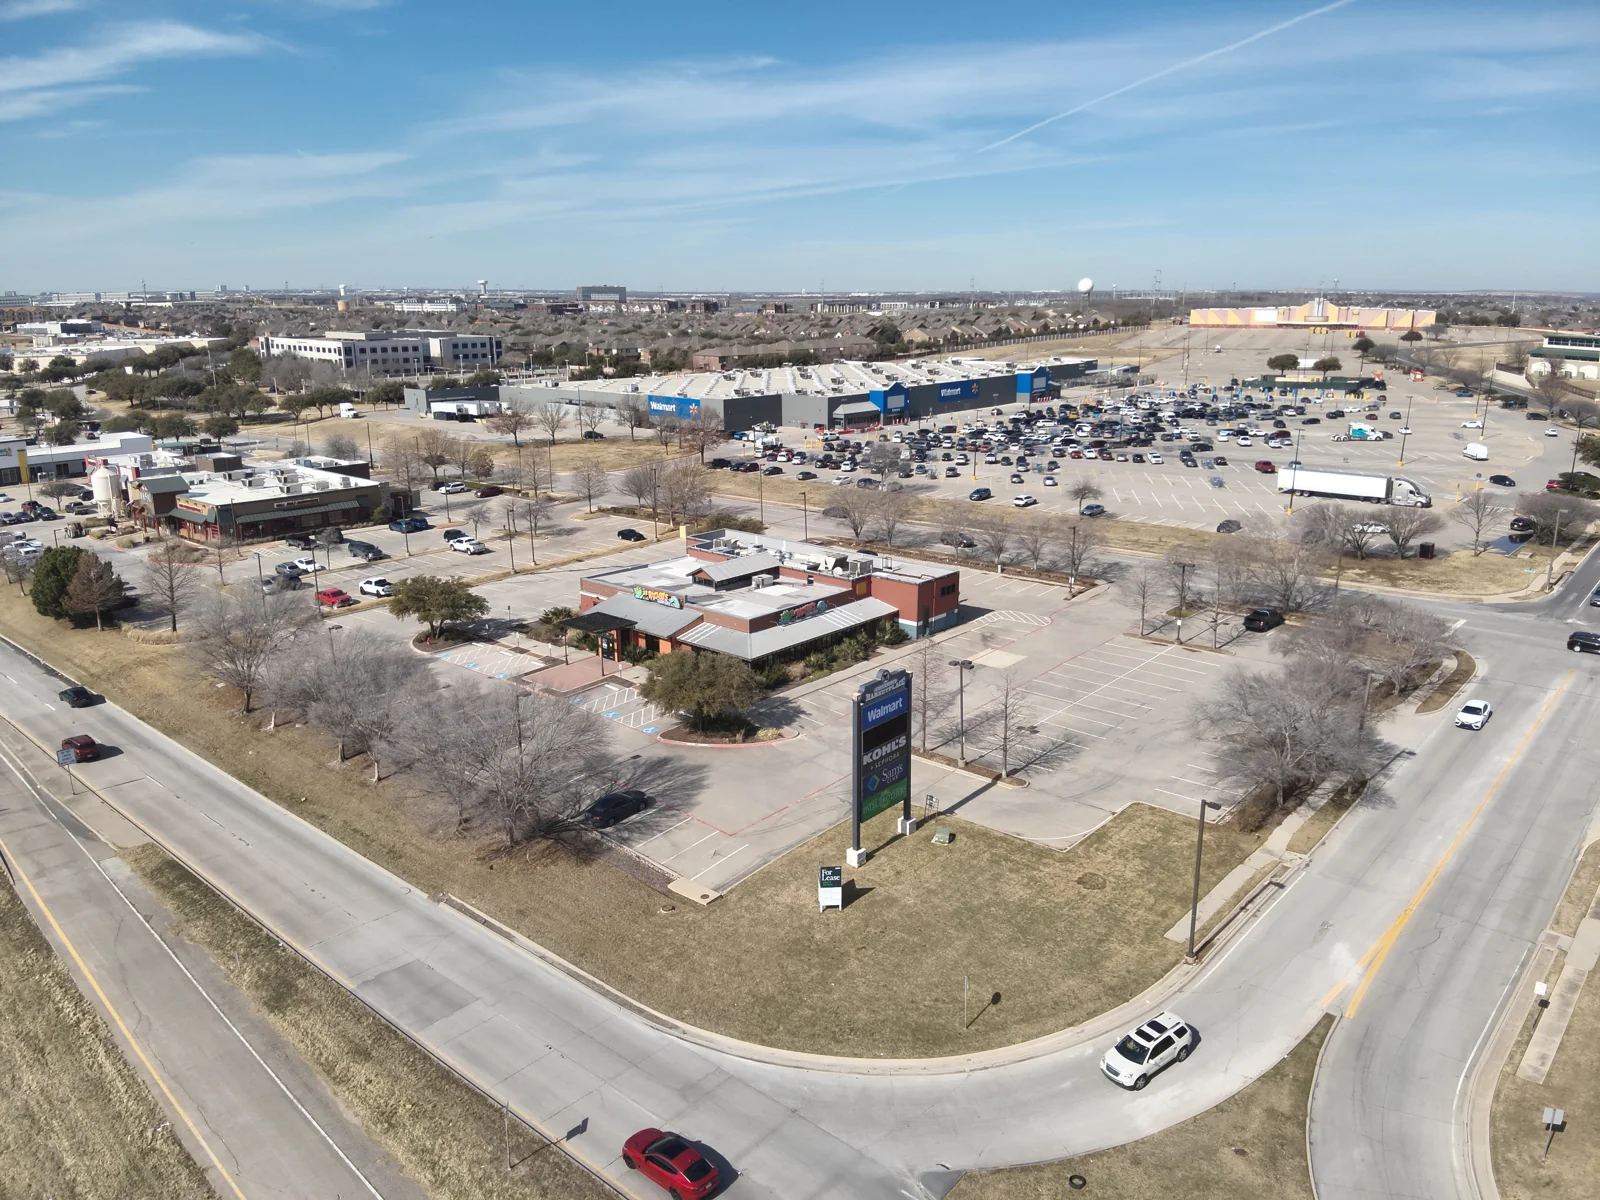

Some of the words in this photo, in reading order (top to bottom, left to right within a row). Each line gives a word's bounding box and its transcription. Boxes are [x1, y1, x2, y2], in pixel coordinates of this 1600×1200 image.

[941, 387, 961, 397] Walmart
[650, 401, 676, 412] Walmart
[867, 697, 903, 722] Walmart
[862, 735, 907, 766] KOHL'S
[874, 752, 900, 769] SEPHORA
